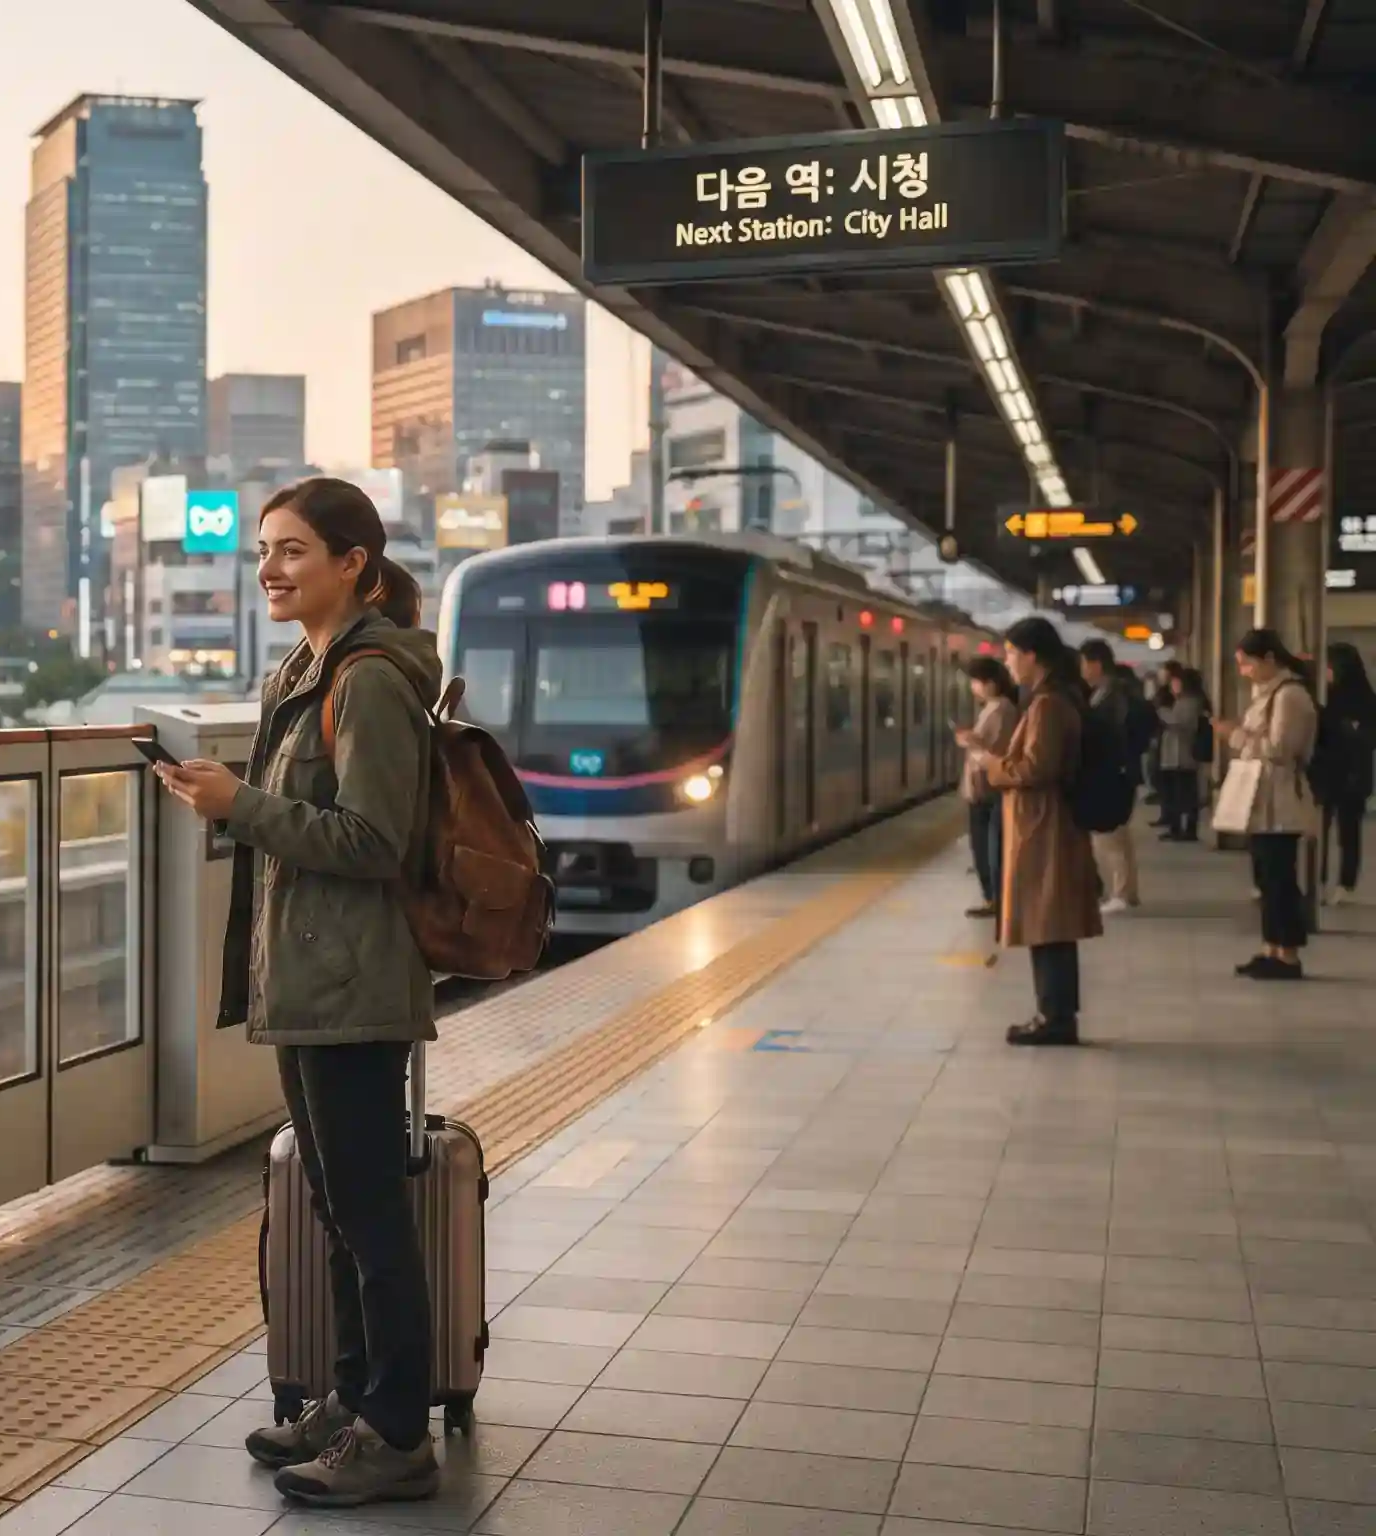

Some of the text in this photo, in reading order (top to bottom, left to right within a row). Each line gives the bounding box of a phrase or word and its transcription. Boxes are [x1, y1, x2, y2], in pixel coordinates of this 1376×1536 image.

[696, 151, 929, 211] 다음 역: 시청
[675, 203, 948, 247] Next Station: City Hall
